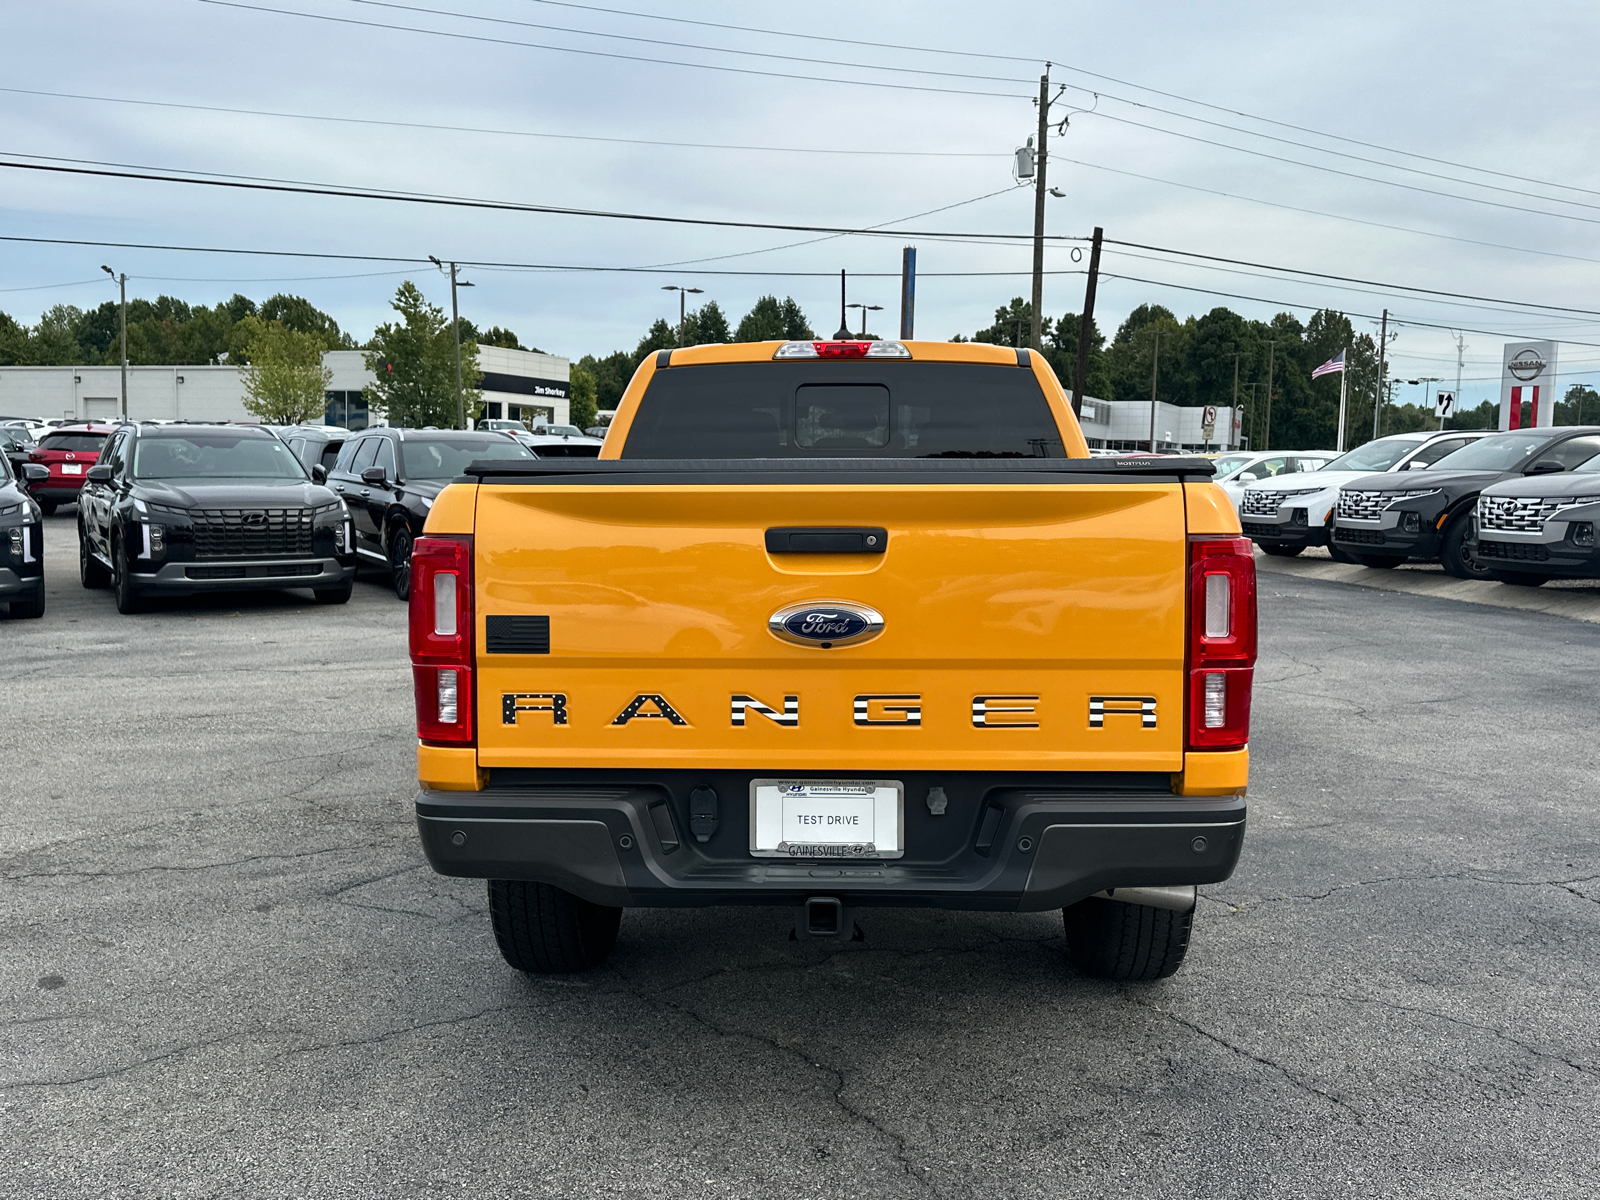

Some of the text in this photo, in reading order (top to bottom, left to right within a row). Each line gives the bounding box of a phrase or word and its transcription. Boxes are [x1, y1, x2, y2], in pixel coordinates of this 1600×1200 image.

[534, 386, 565, 397] Jim Shorkey
[801, 613, 850, 633] Ford
[501, 692, 1157, 728] RANGER
[797, 815, 859, 825] TEST DRIVE
[788, 845, 848, 857] GAINESVILLE
